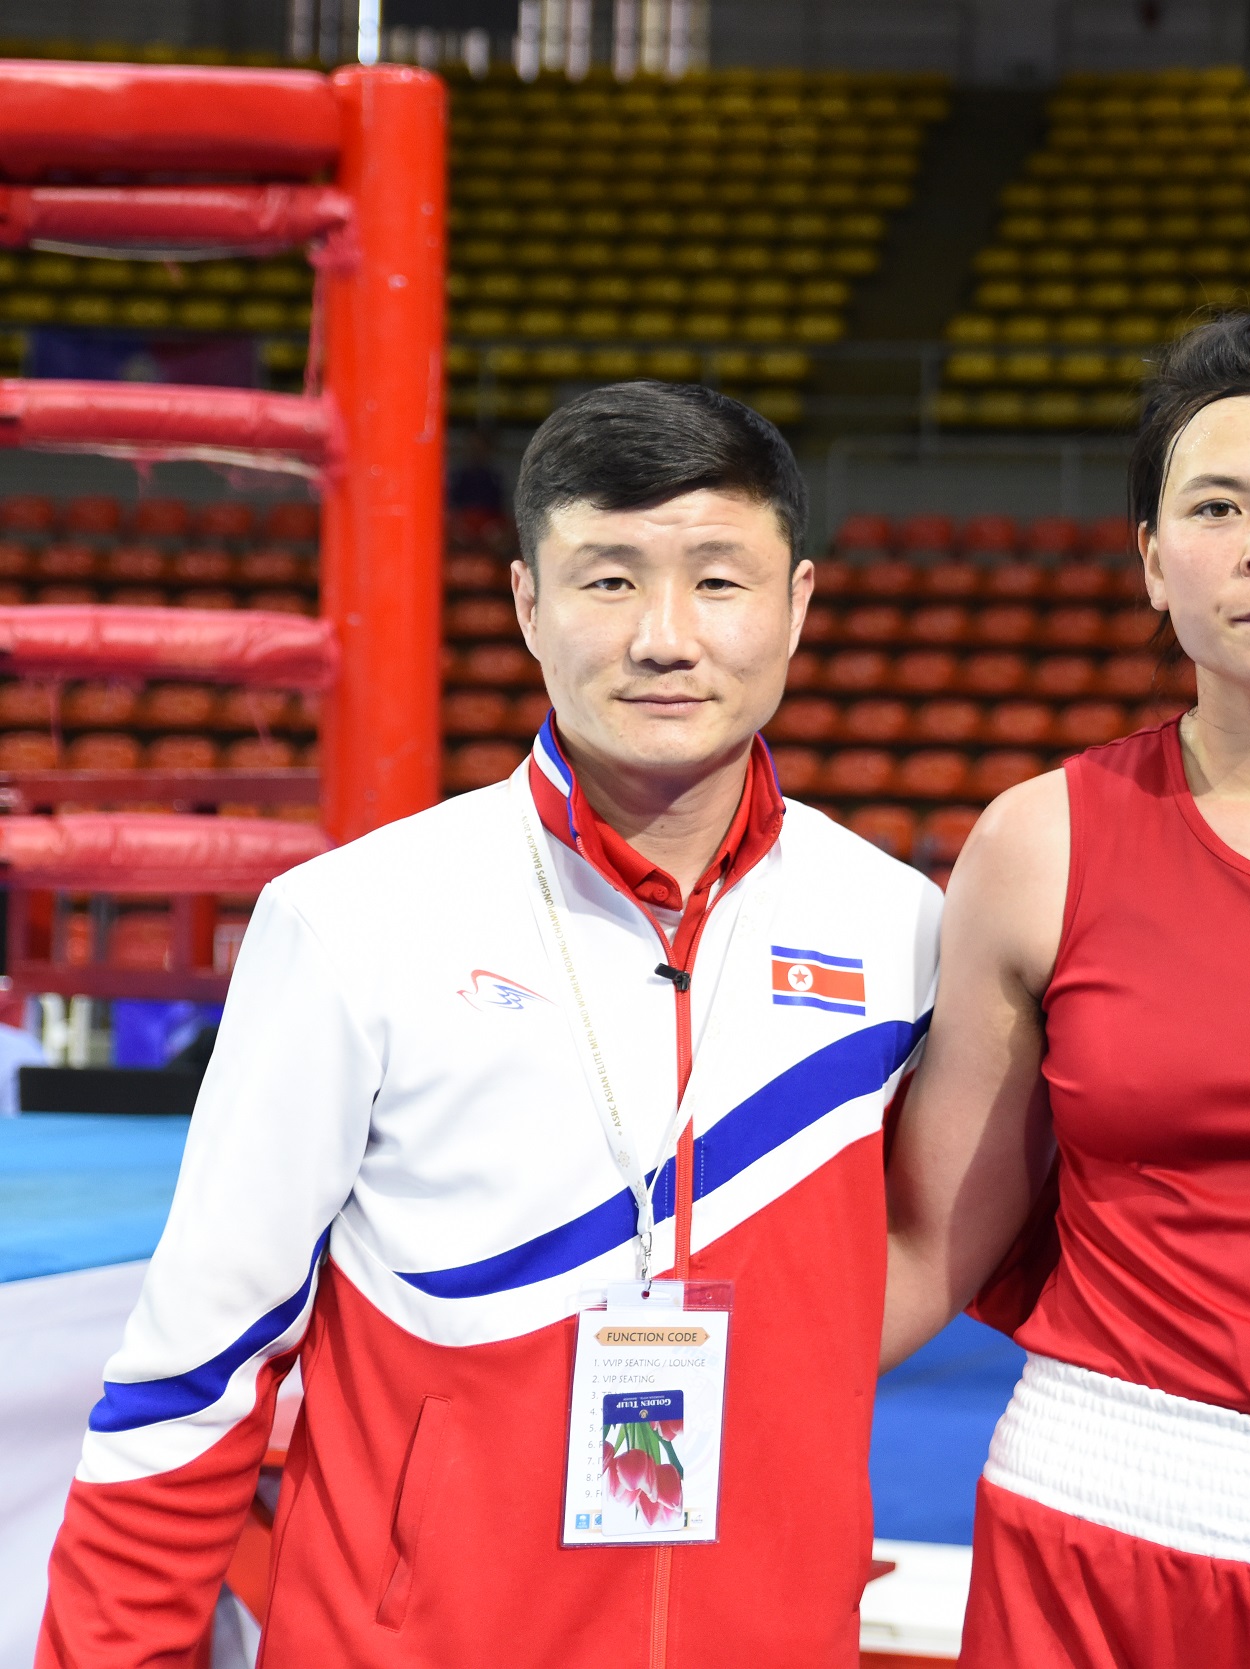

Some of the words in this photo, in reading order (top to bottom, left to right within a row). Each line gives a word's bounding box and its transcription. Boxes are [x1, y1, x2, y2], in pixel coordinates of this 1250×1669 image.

[526, 834, 543, 869] BANGKOK
[536, 869, 564, 939] CHAMPIONSHIPS
[558, 940, 575, 973] BOXING
[569, 974, 586, 1008] WOMEN
[580, 1009, 592, 1028] AND
[587, 1030, 599, 1050] MEN
[593, 1051, 606, 1075] ELITE
[600, 1075, 615, 1103] ASIAN
[608, 1104, 622, 1127] ASBC
[606, 1332, 664, 1342] FUNCTION
[667, 1332, 698, 1342] CODE
[602, 1359, 623, 1367] VVIP
[625, 1359, 661, 1368] SEATING
[669, 1359, 706, 1368] LOUNGE
[592, 1375, 599, 1384] 2.
[602, 1375, 617, 1384] VIP
[619, 1375, 656, 1384] SEATING
[616, 1400, 639, 1409] TULIP
[641, 1398, 671, 1407] GOLDEN
